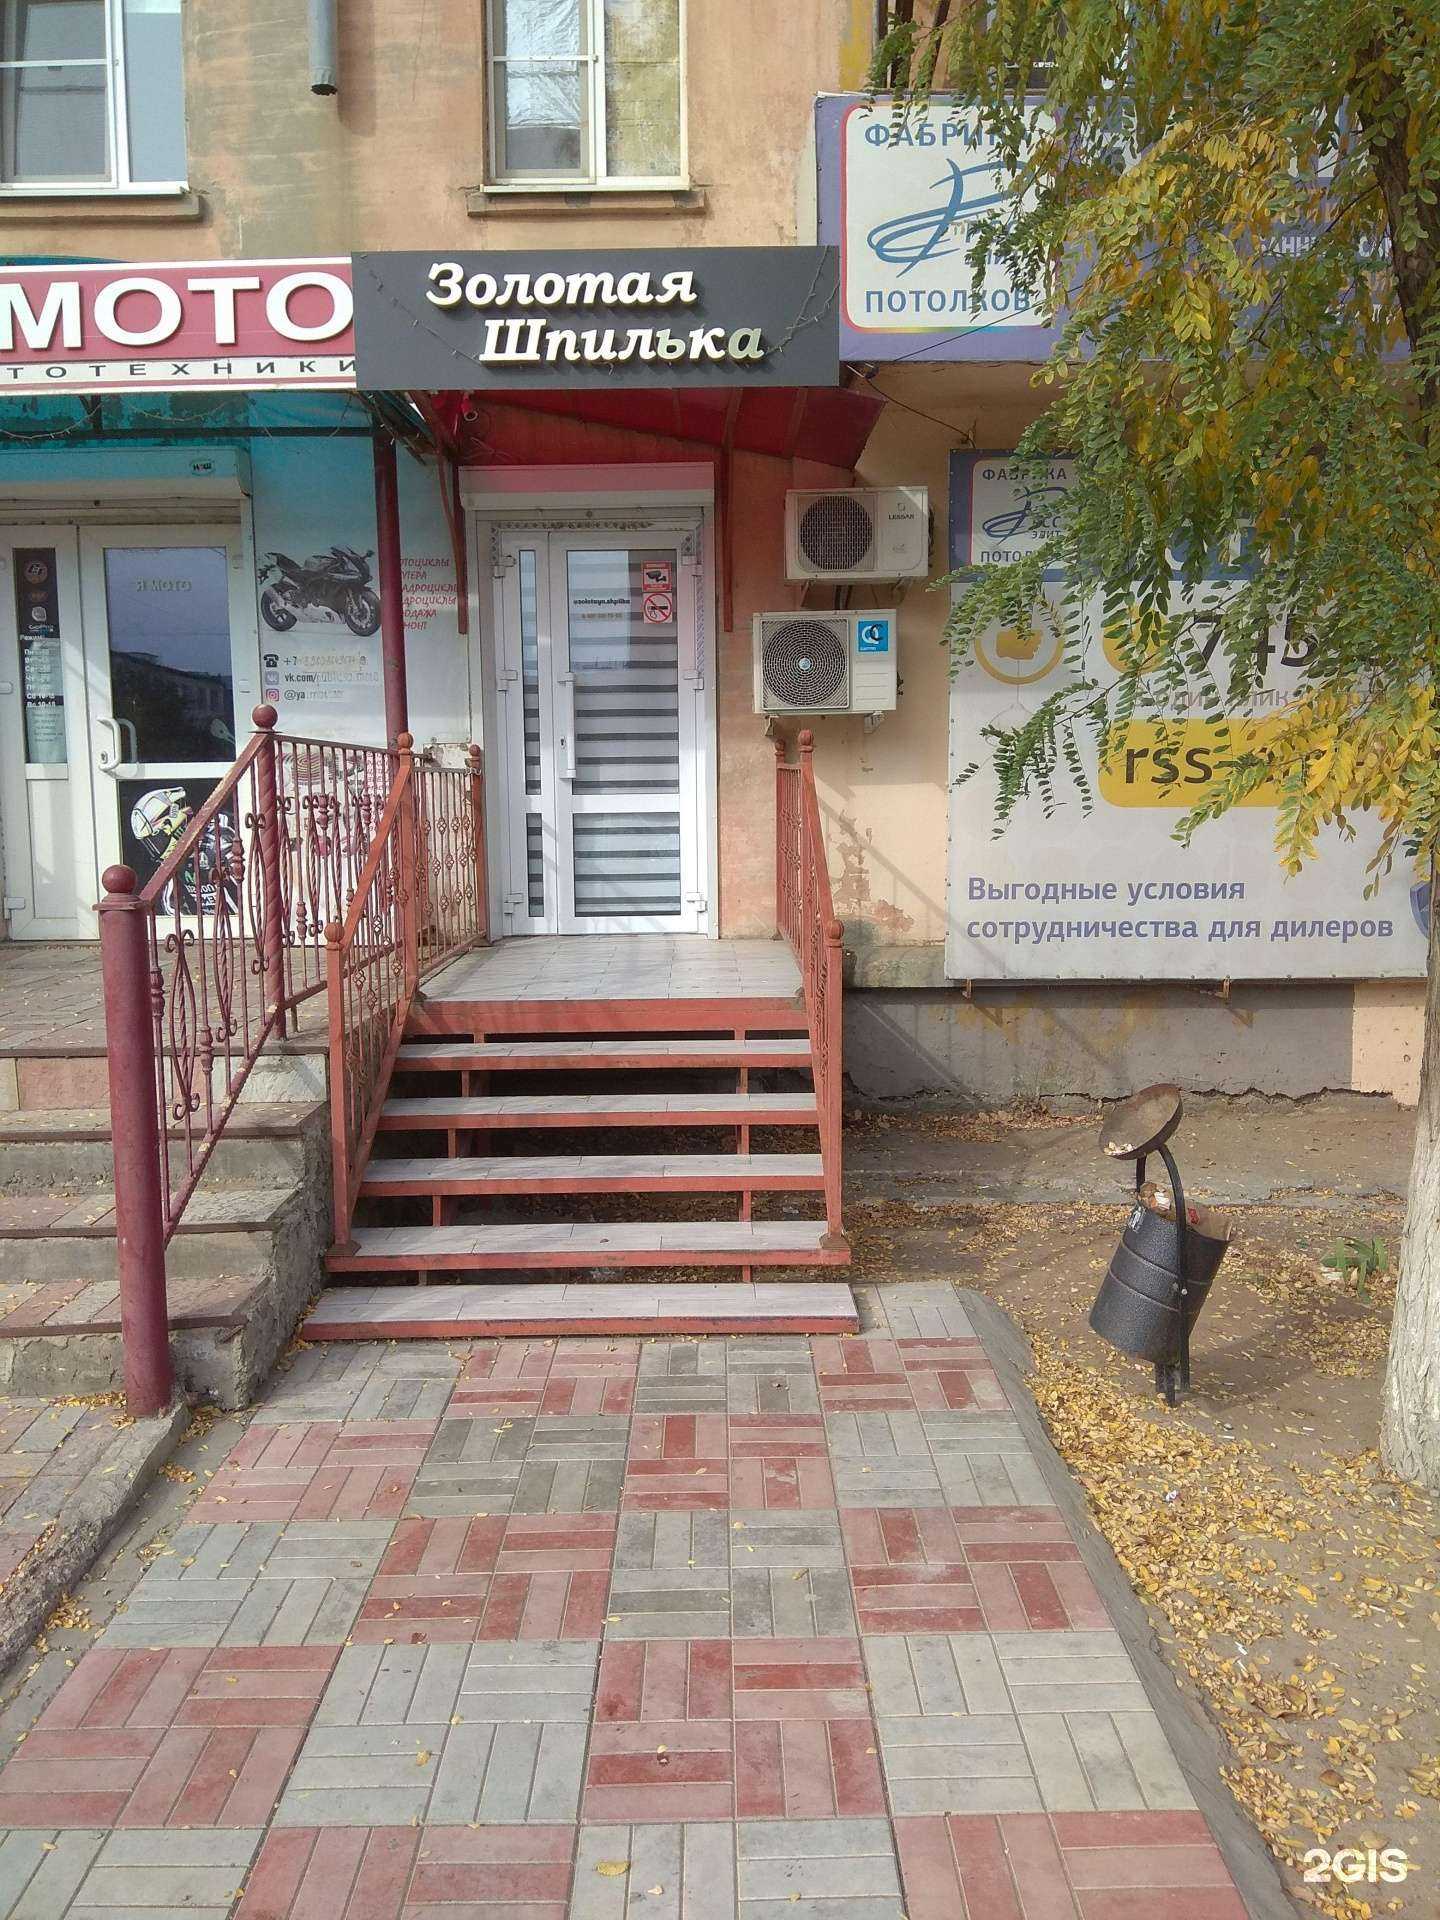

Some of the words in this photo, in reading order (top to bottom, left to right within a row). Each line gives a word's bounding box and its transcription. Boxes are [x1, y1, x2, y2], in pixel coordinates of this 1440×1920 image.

[426, 262, 697, 308] Золотая
[479, 318, 764, 363] Шпилька
[968, 877, 1118, 905] Выгодные
[1127, 881, 1246, 906] условия
[967, 917, 1199, 945] сотрудничества
[1207, 918, 1262, 943] для
[1270, 918, 1394, 943] дилеров
